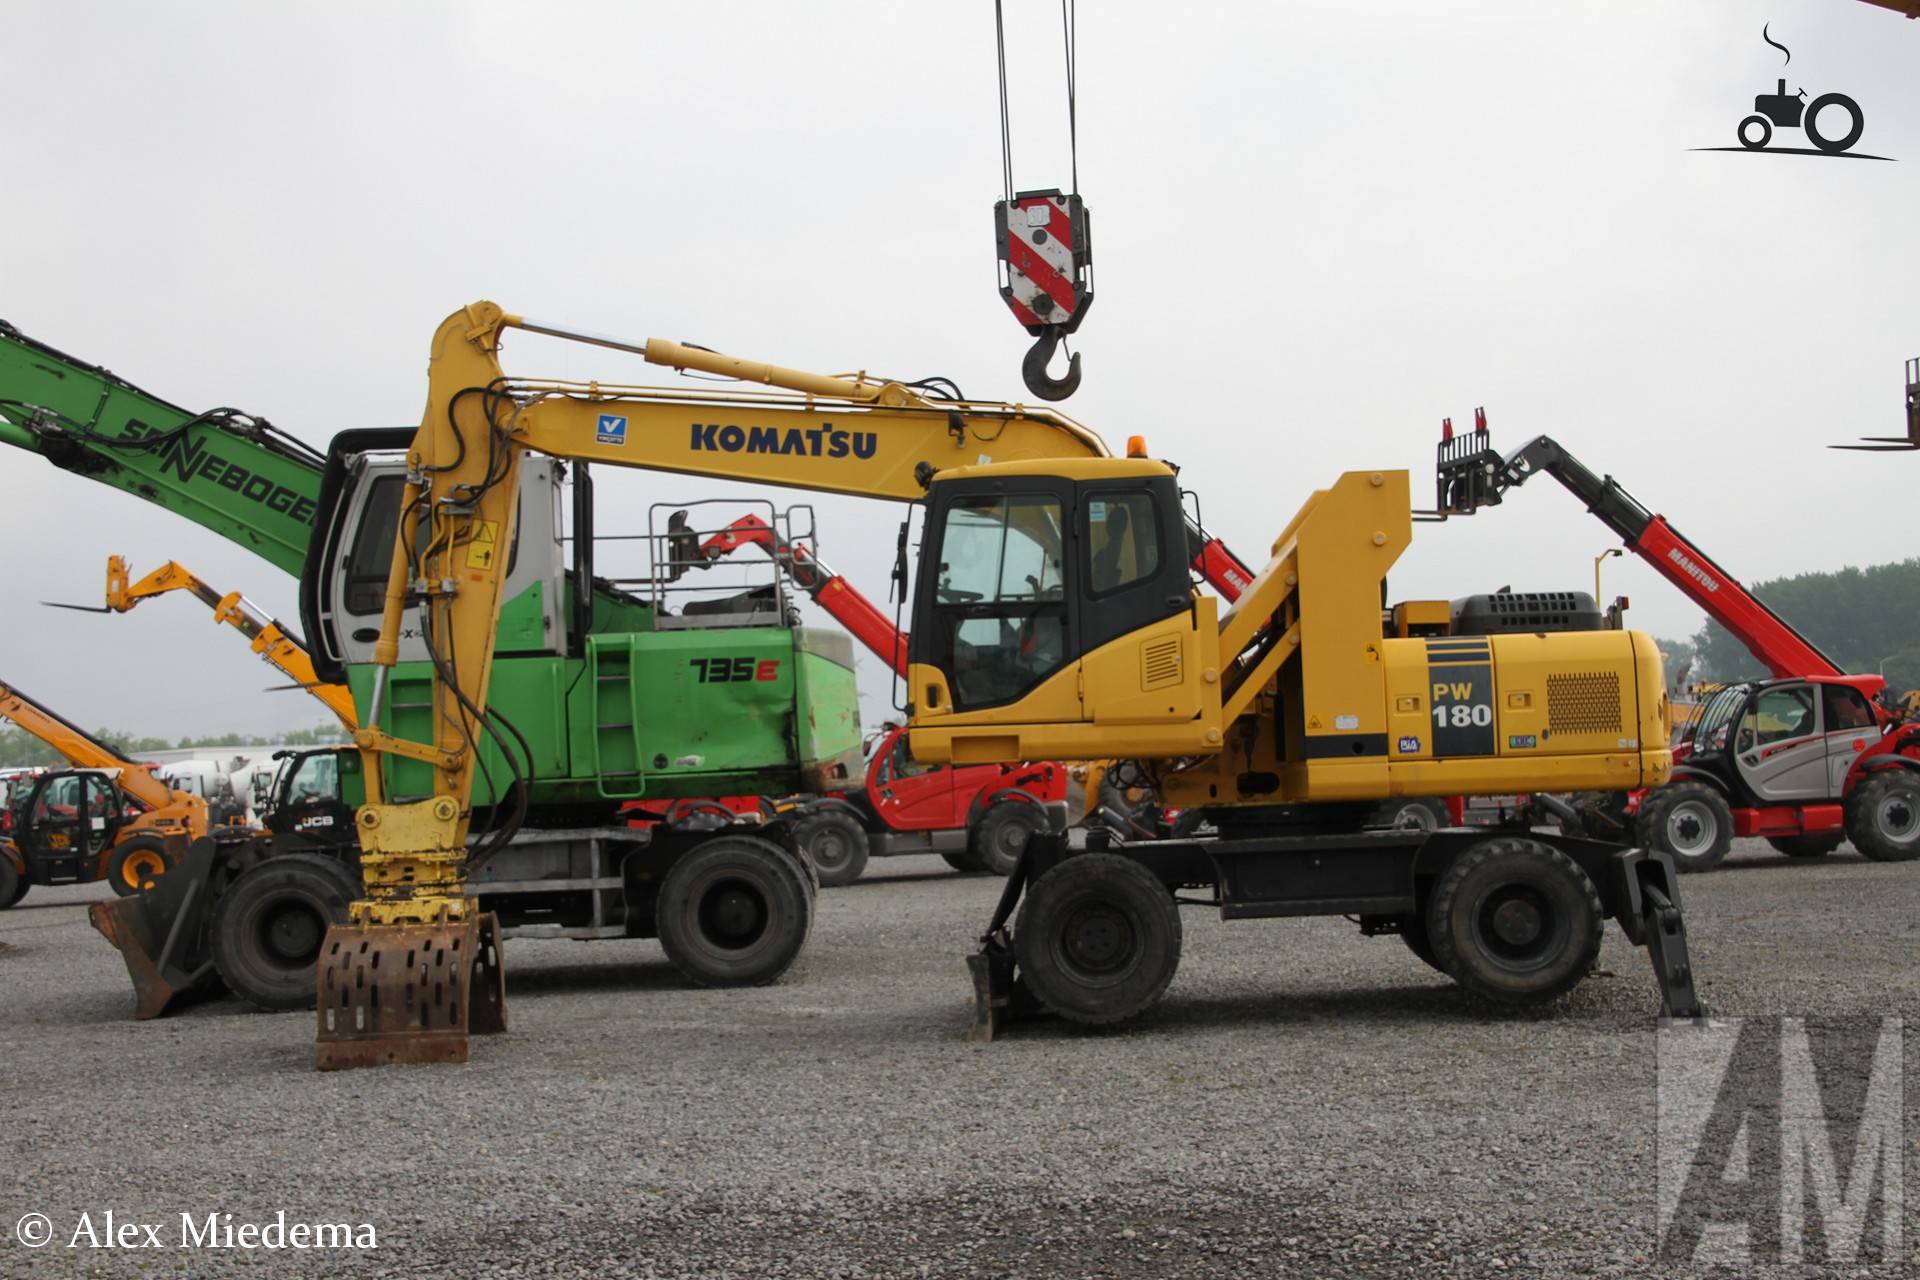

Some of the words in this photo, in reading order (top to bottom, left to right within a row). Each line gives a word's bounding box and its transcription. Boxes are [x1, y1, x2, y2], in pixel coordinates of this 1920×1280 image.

[690, 423, 877, 460] KOMATSU
[118, 418, 318, 527] SNNEBOGE
[1667, 547, 1719, 593] MANITOU
[690, 657, 780, 683] 735E
[1433, 682, 1472, 701] PW
[1432, 704, 1492, 728] 180
[302, 816, 334, 828] JCB
